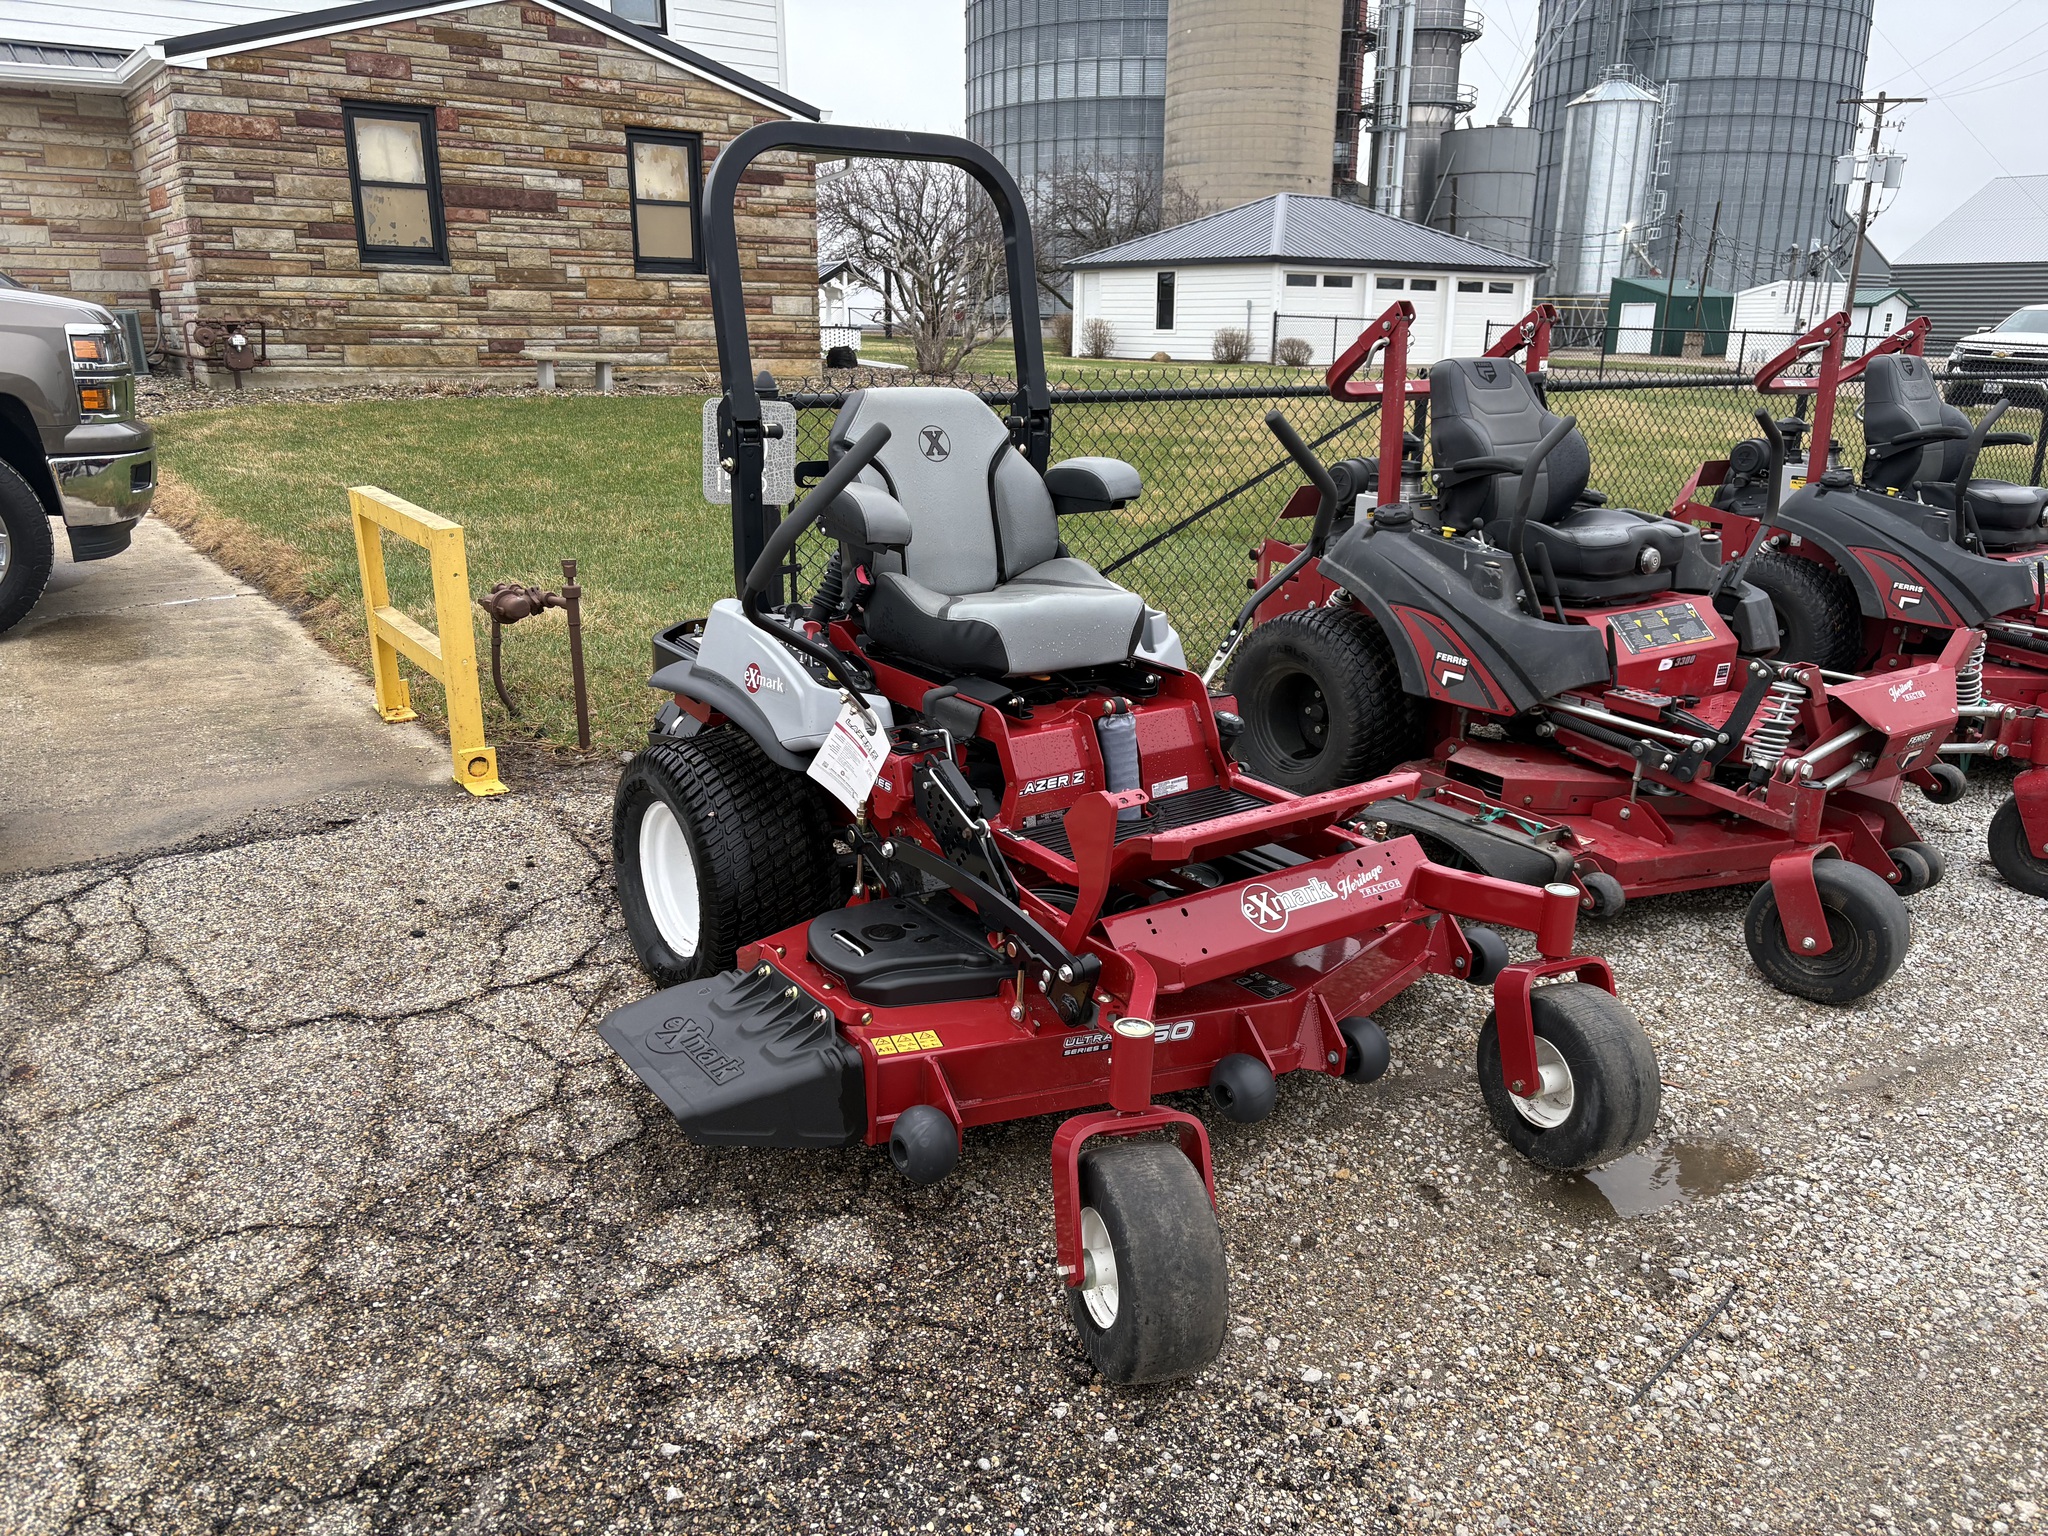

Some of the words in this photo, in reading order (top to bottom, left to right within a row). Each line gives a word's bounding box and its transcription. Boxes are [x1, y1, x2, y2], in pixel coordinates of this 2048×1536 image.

[921, 429, 949, 458] X
[1893, 581, 1924, 593] FERRIS
[1436, 651, 1468, 667] FERRIS
[744, 666, 784, 693] eXmark
[1073, 771, 1085, 785] Z
[1242, 877, 1336, 928] eXmark
[1337, 865, 1383, 901] Heritage
[1360, 878, 1402, 899] TRACTOR
[652, 1015, 741, 1082] eXmark
[1064, 1034, 1112, 1048] ULTRA
[1063, 1045, 1100, 1056] SERIES
